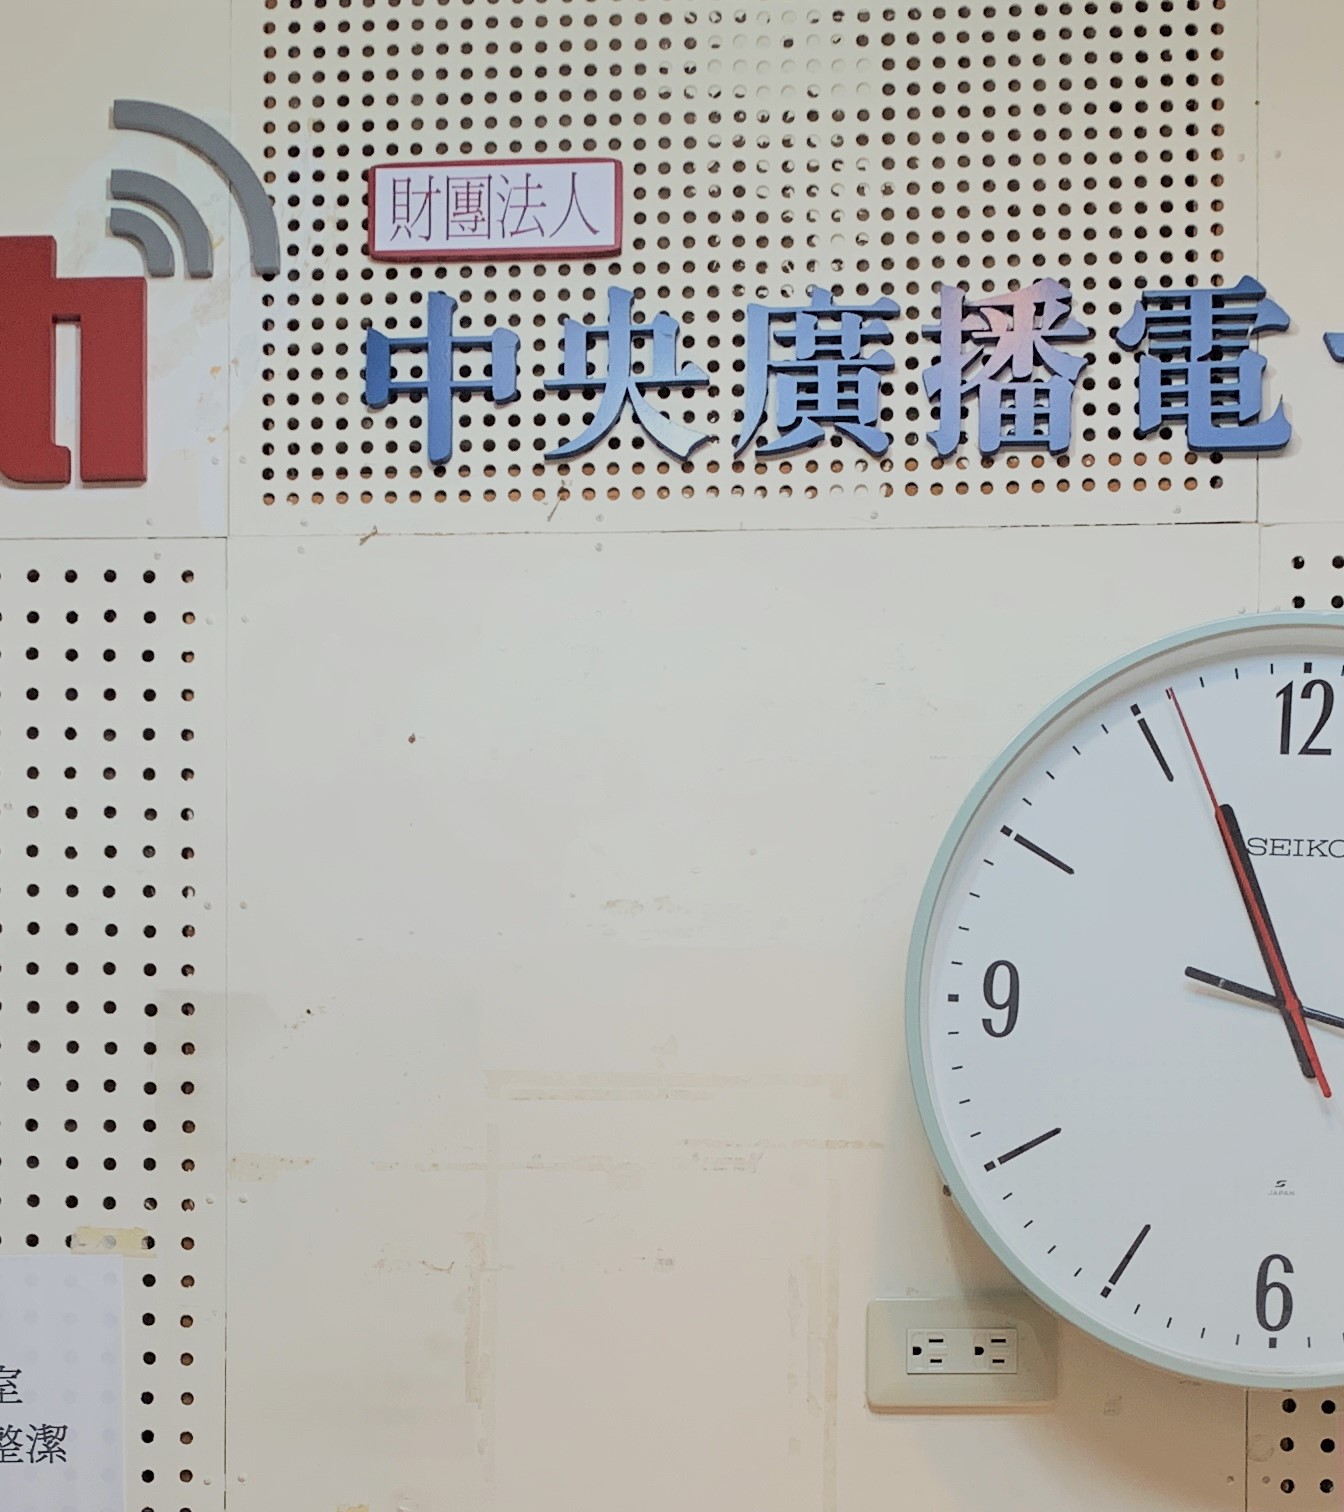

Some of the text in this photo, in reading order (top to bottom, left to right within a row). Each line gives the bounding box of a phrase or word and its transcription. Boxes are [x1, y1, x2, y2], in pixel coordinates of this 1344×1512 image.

[389, 171, 601, 242] 財團法人
[1275, 679, 1335, 756] 12
[981, 959, 1019, 1037] 9
[1255, 1254, 1295, 1332] 6
